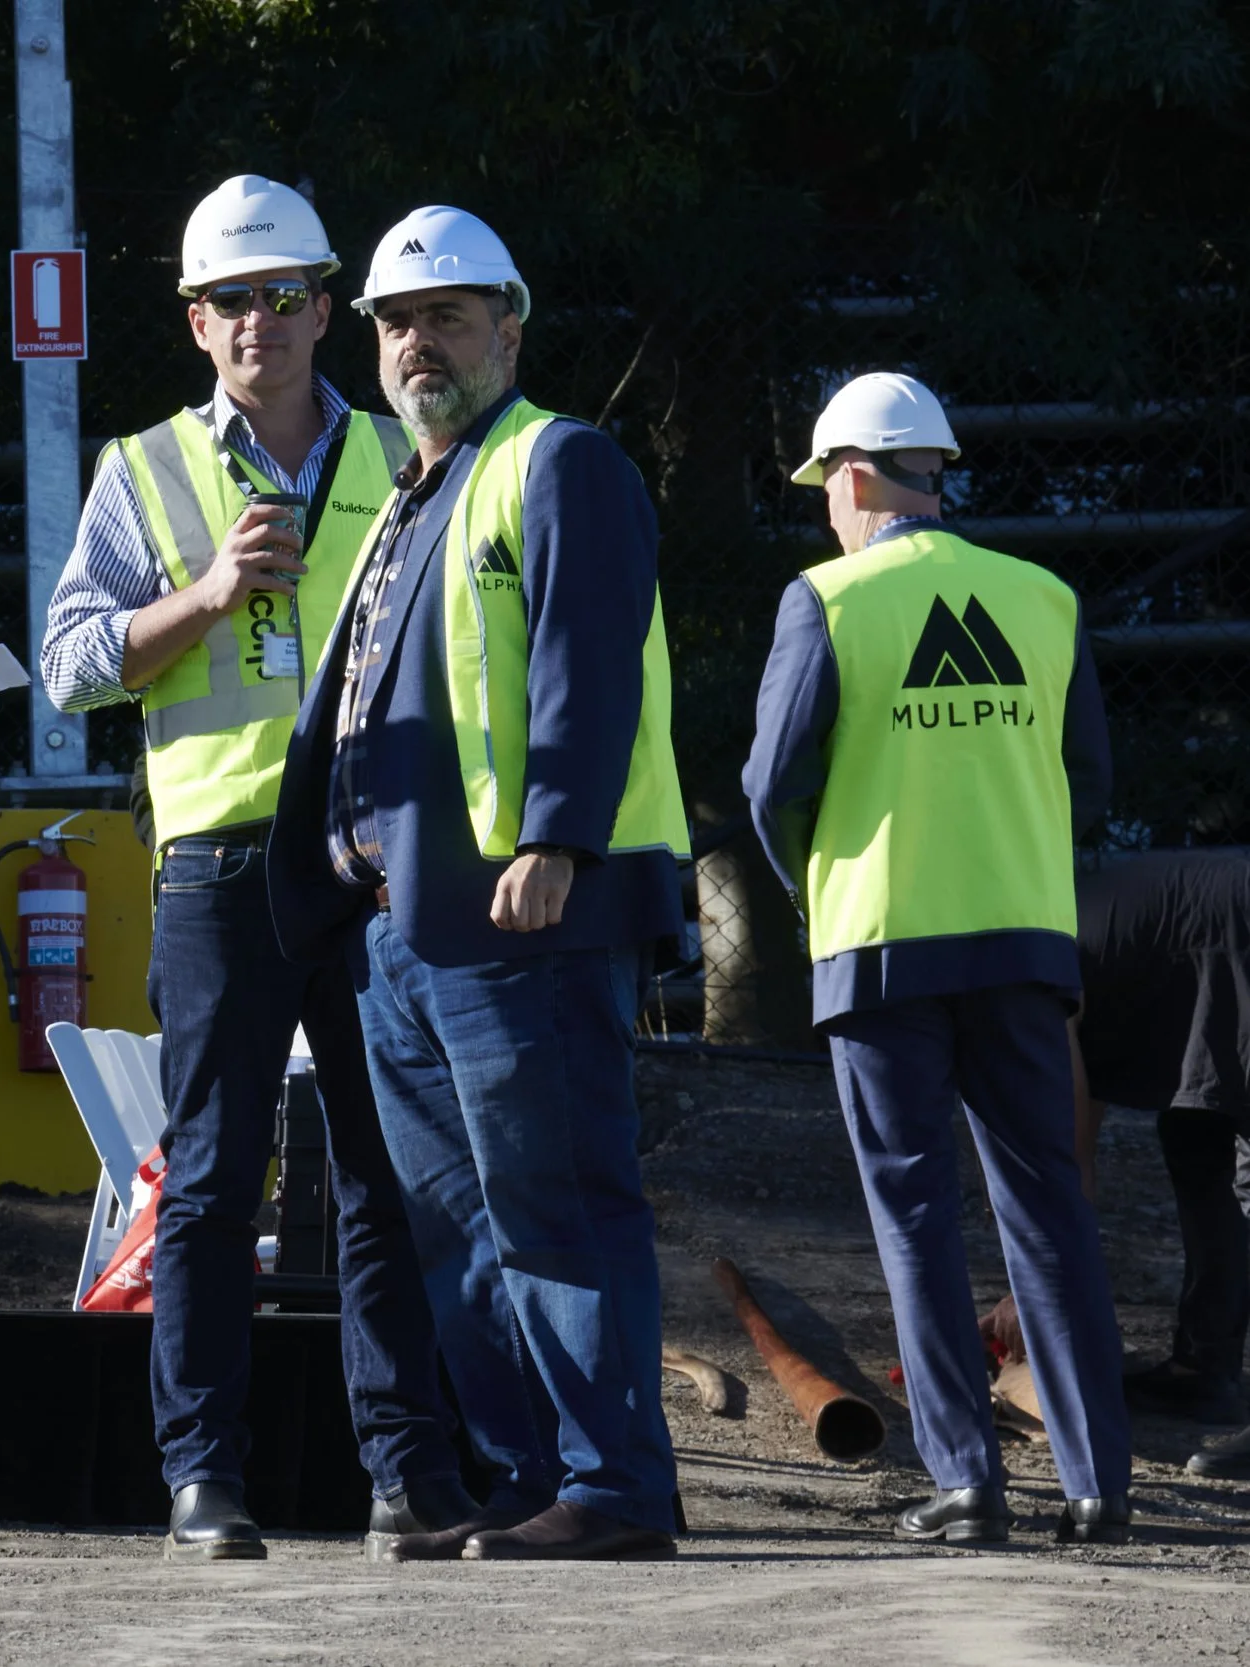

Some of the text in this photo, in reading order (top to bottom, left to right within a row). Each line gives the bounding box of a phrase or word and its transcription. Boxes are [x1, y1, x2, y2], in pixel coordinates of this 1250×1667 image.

[221, 222, 276, 239] Buildcorp
[395, 254, 431, 265] ULPHA
[38, 331, 61, 341] FIRE
[16, 343, 83, 353] EXTINGUISHER
